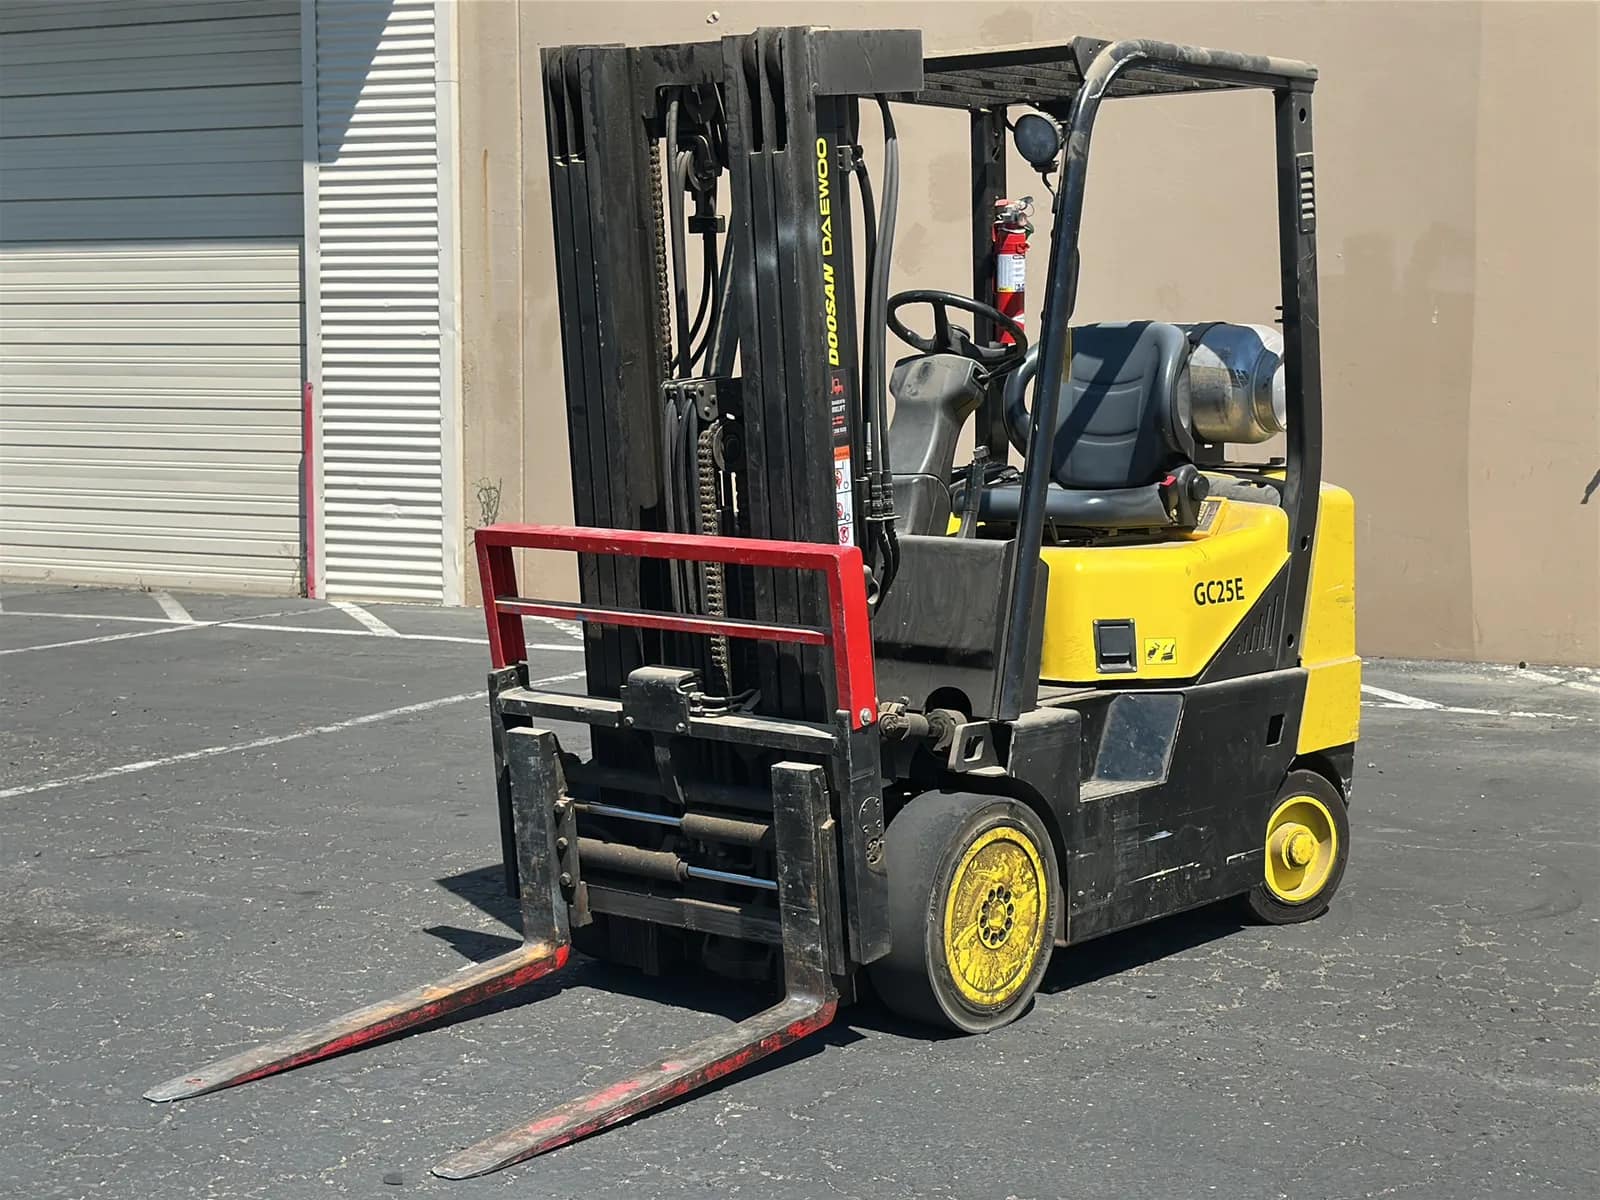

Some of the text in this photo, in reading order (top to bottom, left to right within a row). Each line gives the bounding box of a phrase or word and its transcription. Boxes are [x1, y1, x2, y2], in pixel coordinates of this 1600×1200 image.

[816, 137, 840, 367] DOOSAN DAEWOO
[1194, 577, 1245, 606] GC25E
